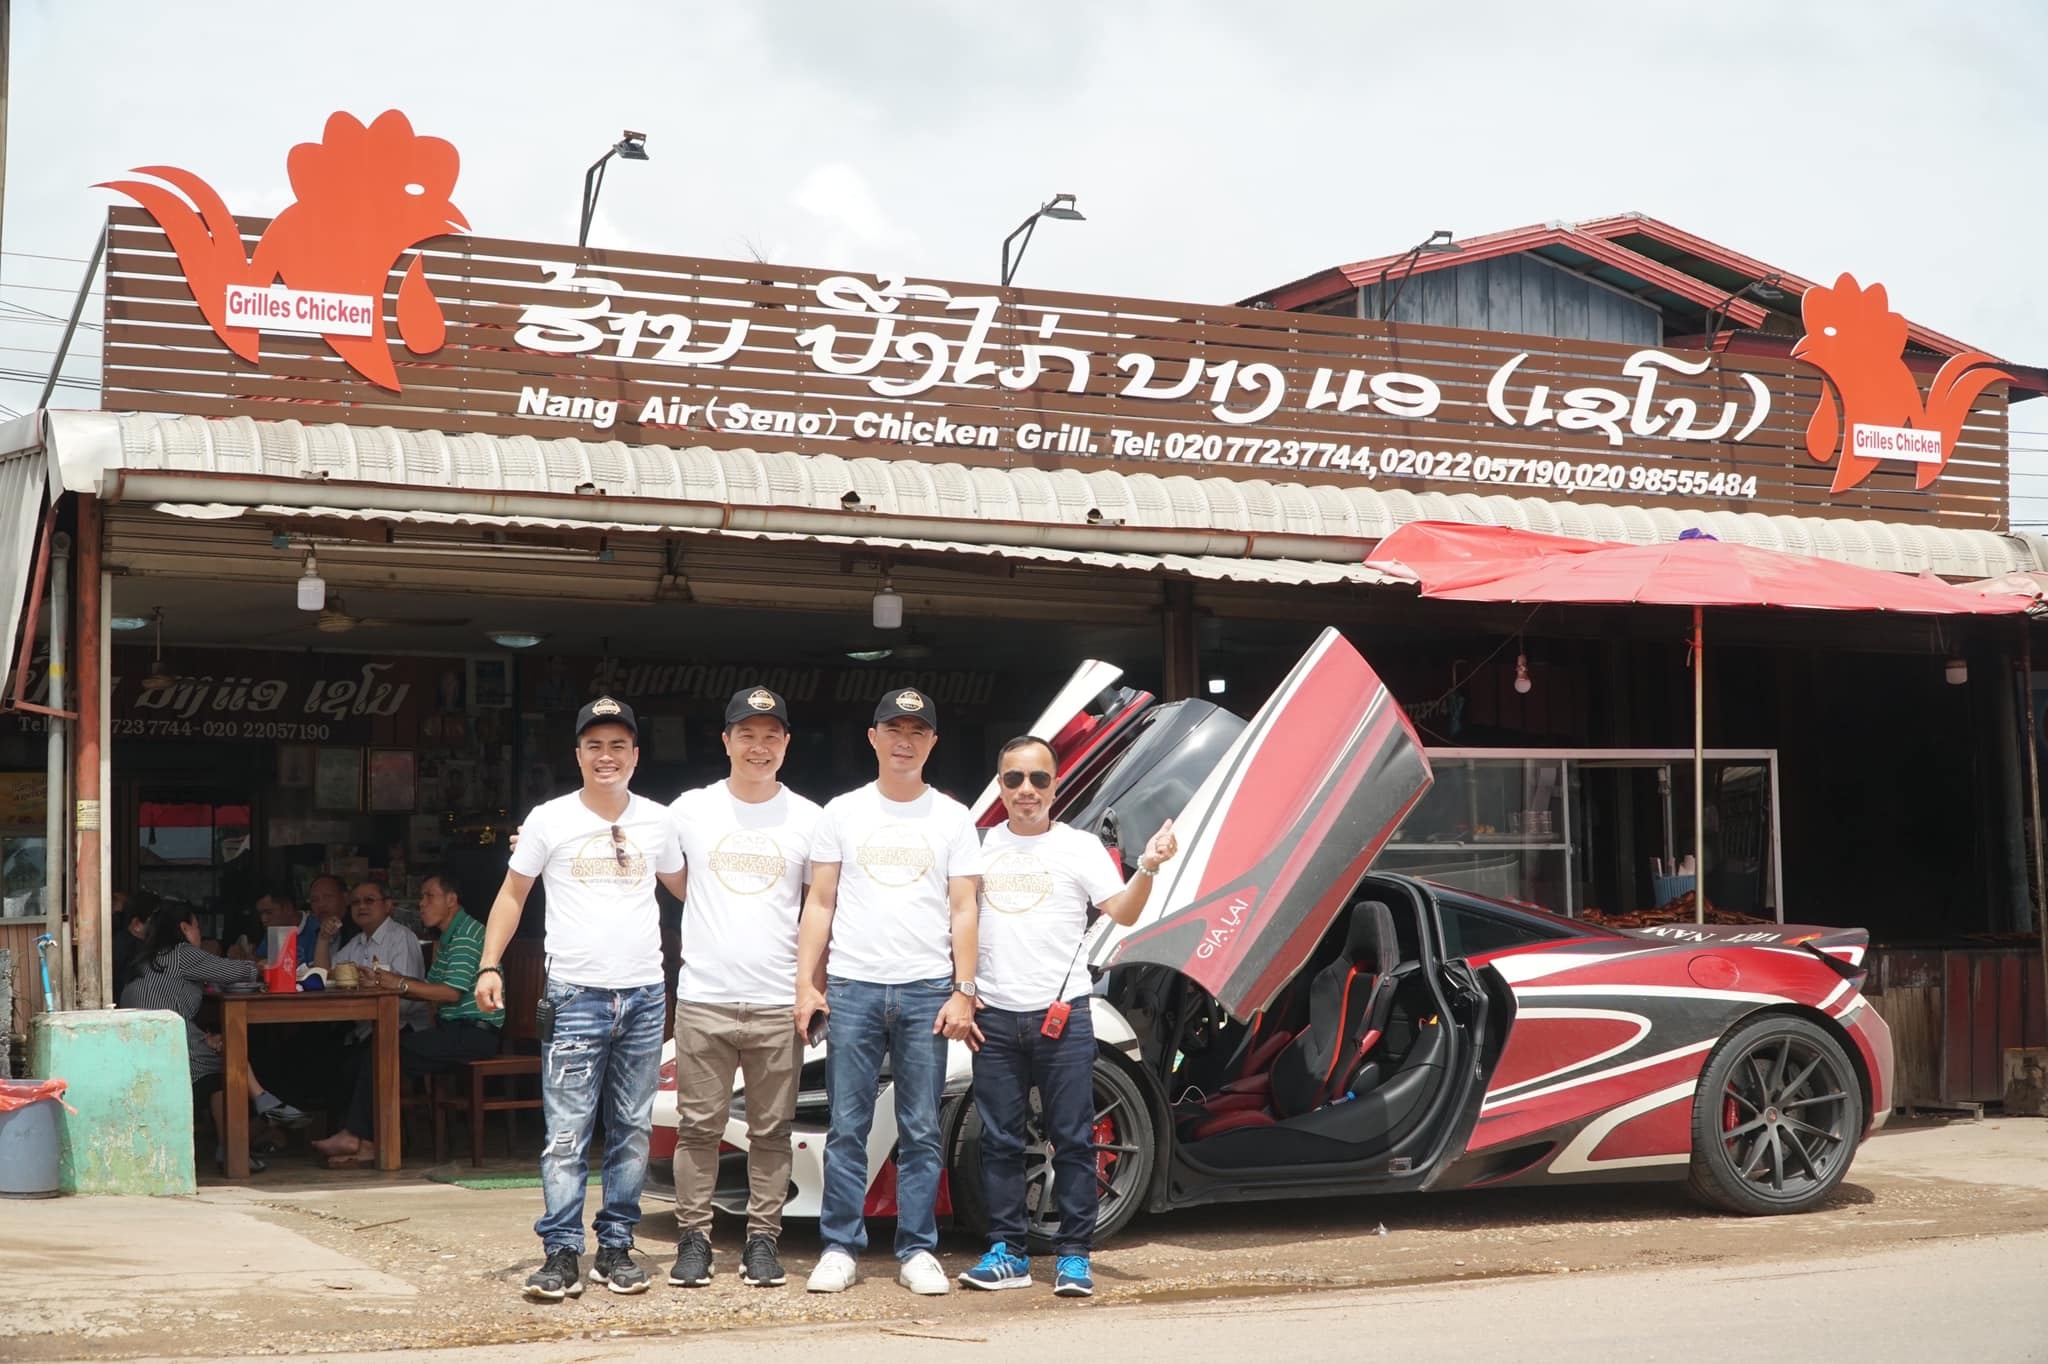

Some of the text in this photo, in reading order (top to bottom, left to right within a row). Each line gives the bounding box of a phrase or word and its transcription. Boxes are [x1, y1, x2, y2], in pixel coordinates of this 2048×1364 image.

[229, 290, 371, 324] Grilles Chicken
[516, 386, 618, 428] Nang
[853, 411, 1000, 447] Chicken
[1015, 423, 1098, 453] Grill.
[1110, 429, 1160, 457] Tel:
[1856, 429, 1941, 454] Grilles Chicken
[242, 721, 330, 741] 22057190
